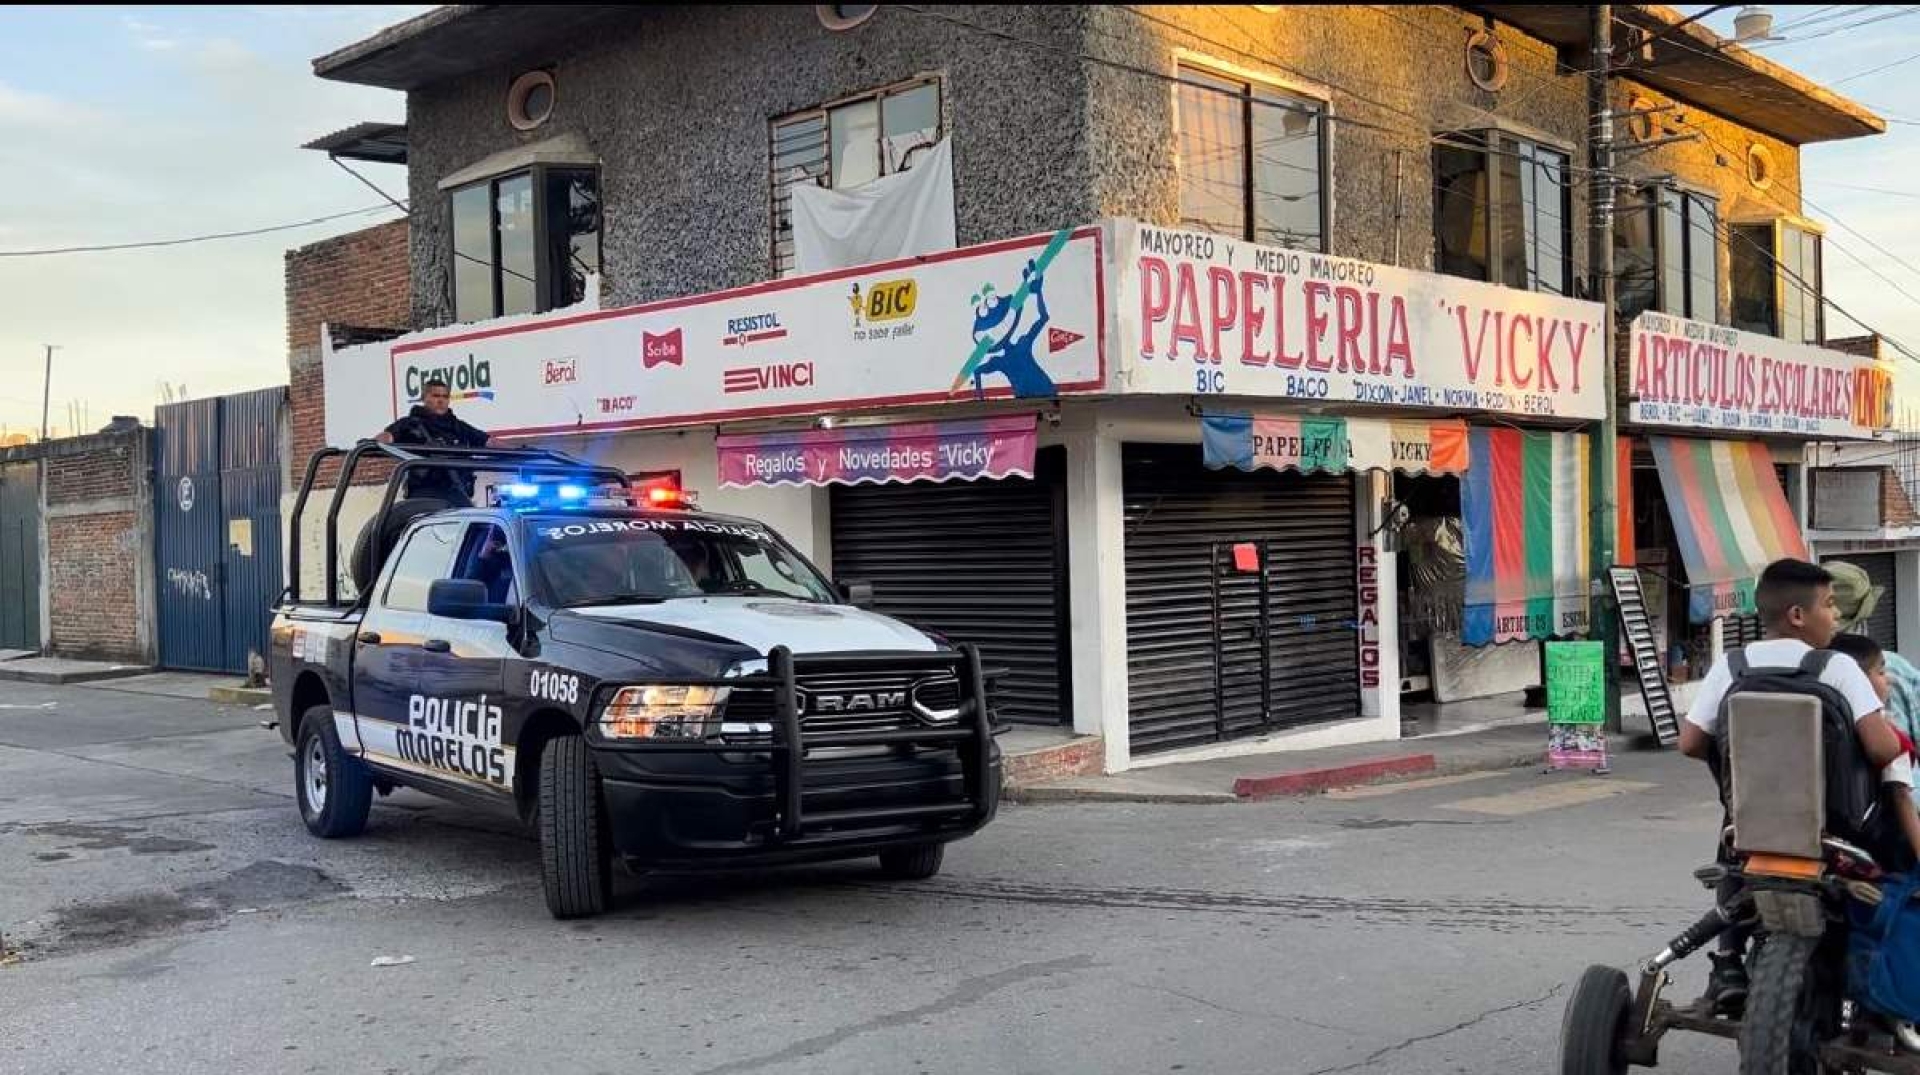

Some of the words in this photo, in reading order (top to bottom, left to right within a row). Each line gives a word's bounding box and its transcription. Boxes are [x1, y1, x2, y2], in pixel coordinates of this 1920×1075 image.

[1140, 228, 1214, 259] MAYOREO
[1226, 245, 1235, 266] Y
[1255, 249, 1300, 275] MEDIO
[1310, 257, 1375, 286] MAYOREO
[870, 282, 911, 317] BIC
[1138, 256, 1415, 378] PAPELERIA
[728, 312, 781, 334] RESISTOL
[545, 360, 577, 385] Berol
[1196, 370, 1225, 393] BIC
[1286, 378, 1329, 398] BACO
[1443, 388, 1479, 408] NORMA
[1525, 394, 1555, 414] BEROL
[1636, 332, 1756, 411] ARTICULOS
[1759, 356, 1852, 420] ESCOLARES
[746, 449, 806, 480] Regalos
[817, 458, 827, 481] y
[839, 447, 932, 470] Novedades
[939, 440, 1002, 470] "Vicky"
[1391, 441, 1433, 461] VICKY
[1358, 545, 1381, 689] REGALOS
[530, 669, 580, 705] 01058
[816, 692, 905, 711] RAM
[396, 727, 505, 783] MORELOS
